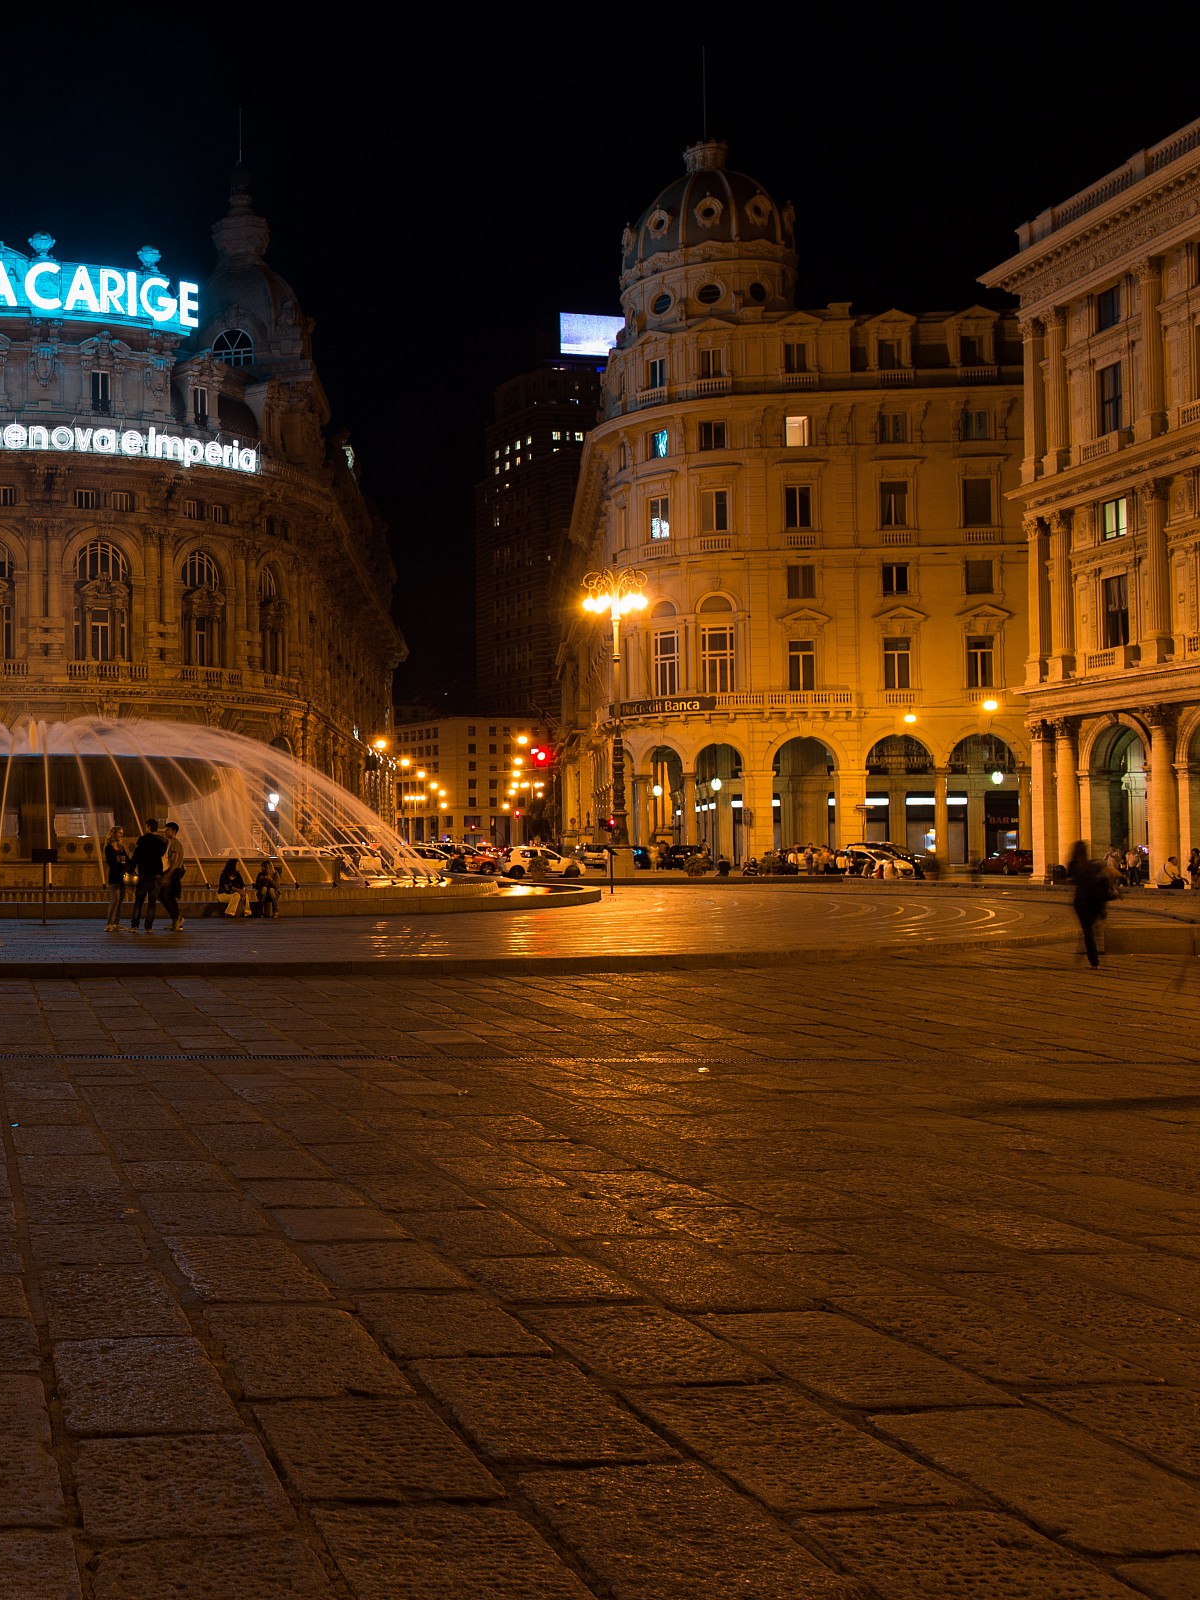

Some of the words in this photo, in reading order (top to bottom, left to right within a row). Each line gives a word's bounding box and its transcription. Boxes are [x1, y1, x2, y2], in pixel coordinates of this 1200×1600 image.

[24, 262, 199, 328] CARIGE
[121, 430, 143, 455] e
[148, 427, 257, 473] Imperia
[622, 701, 663, 715] UniCredit
[664, 700, 700, 712] Banca
[989, 816, 1010, 825] BAR
